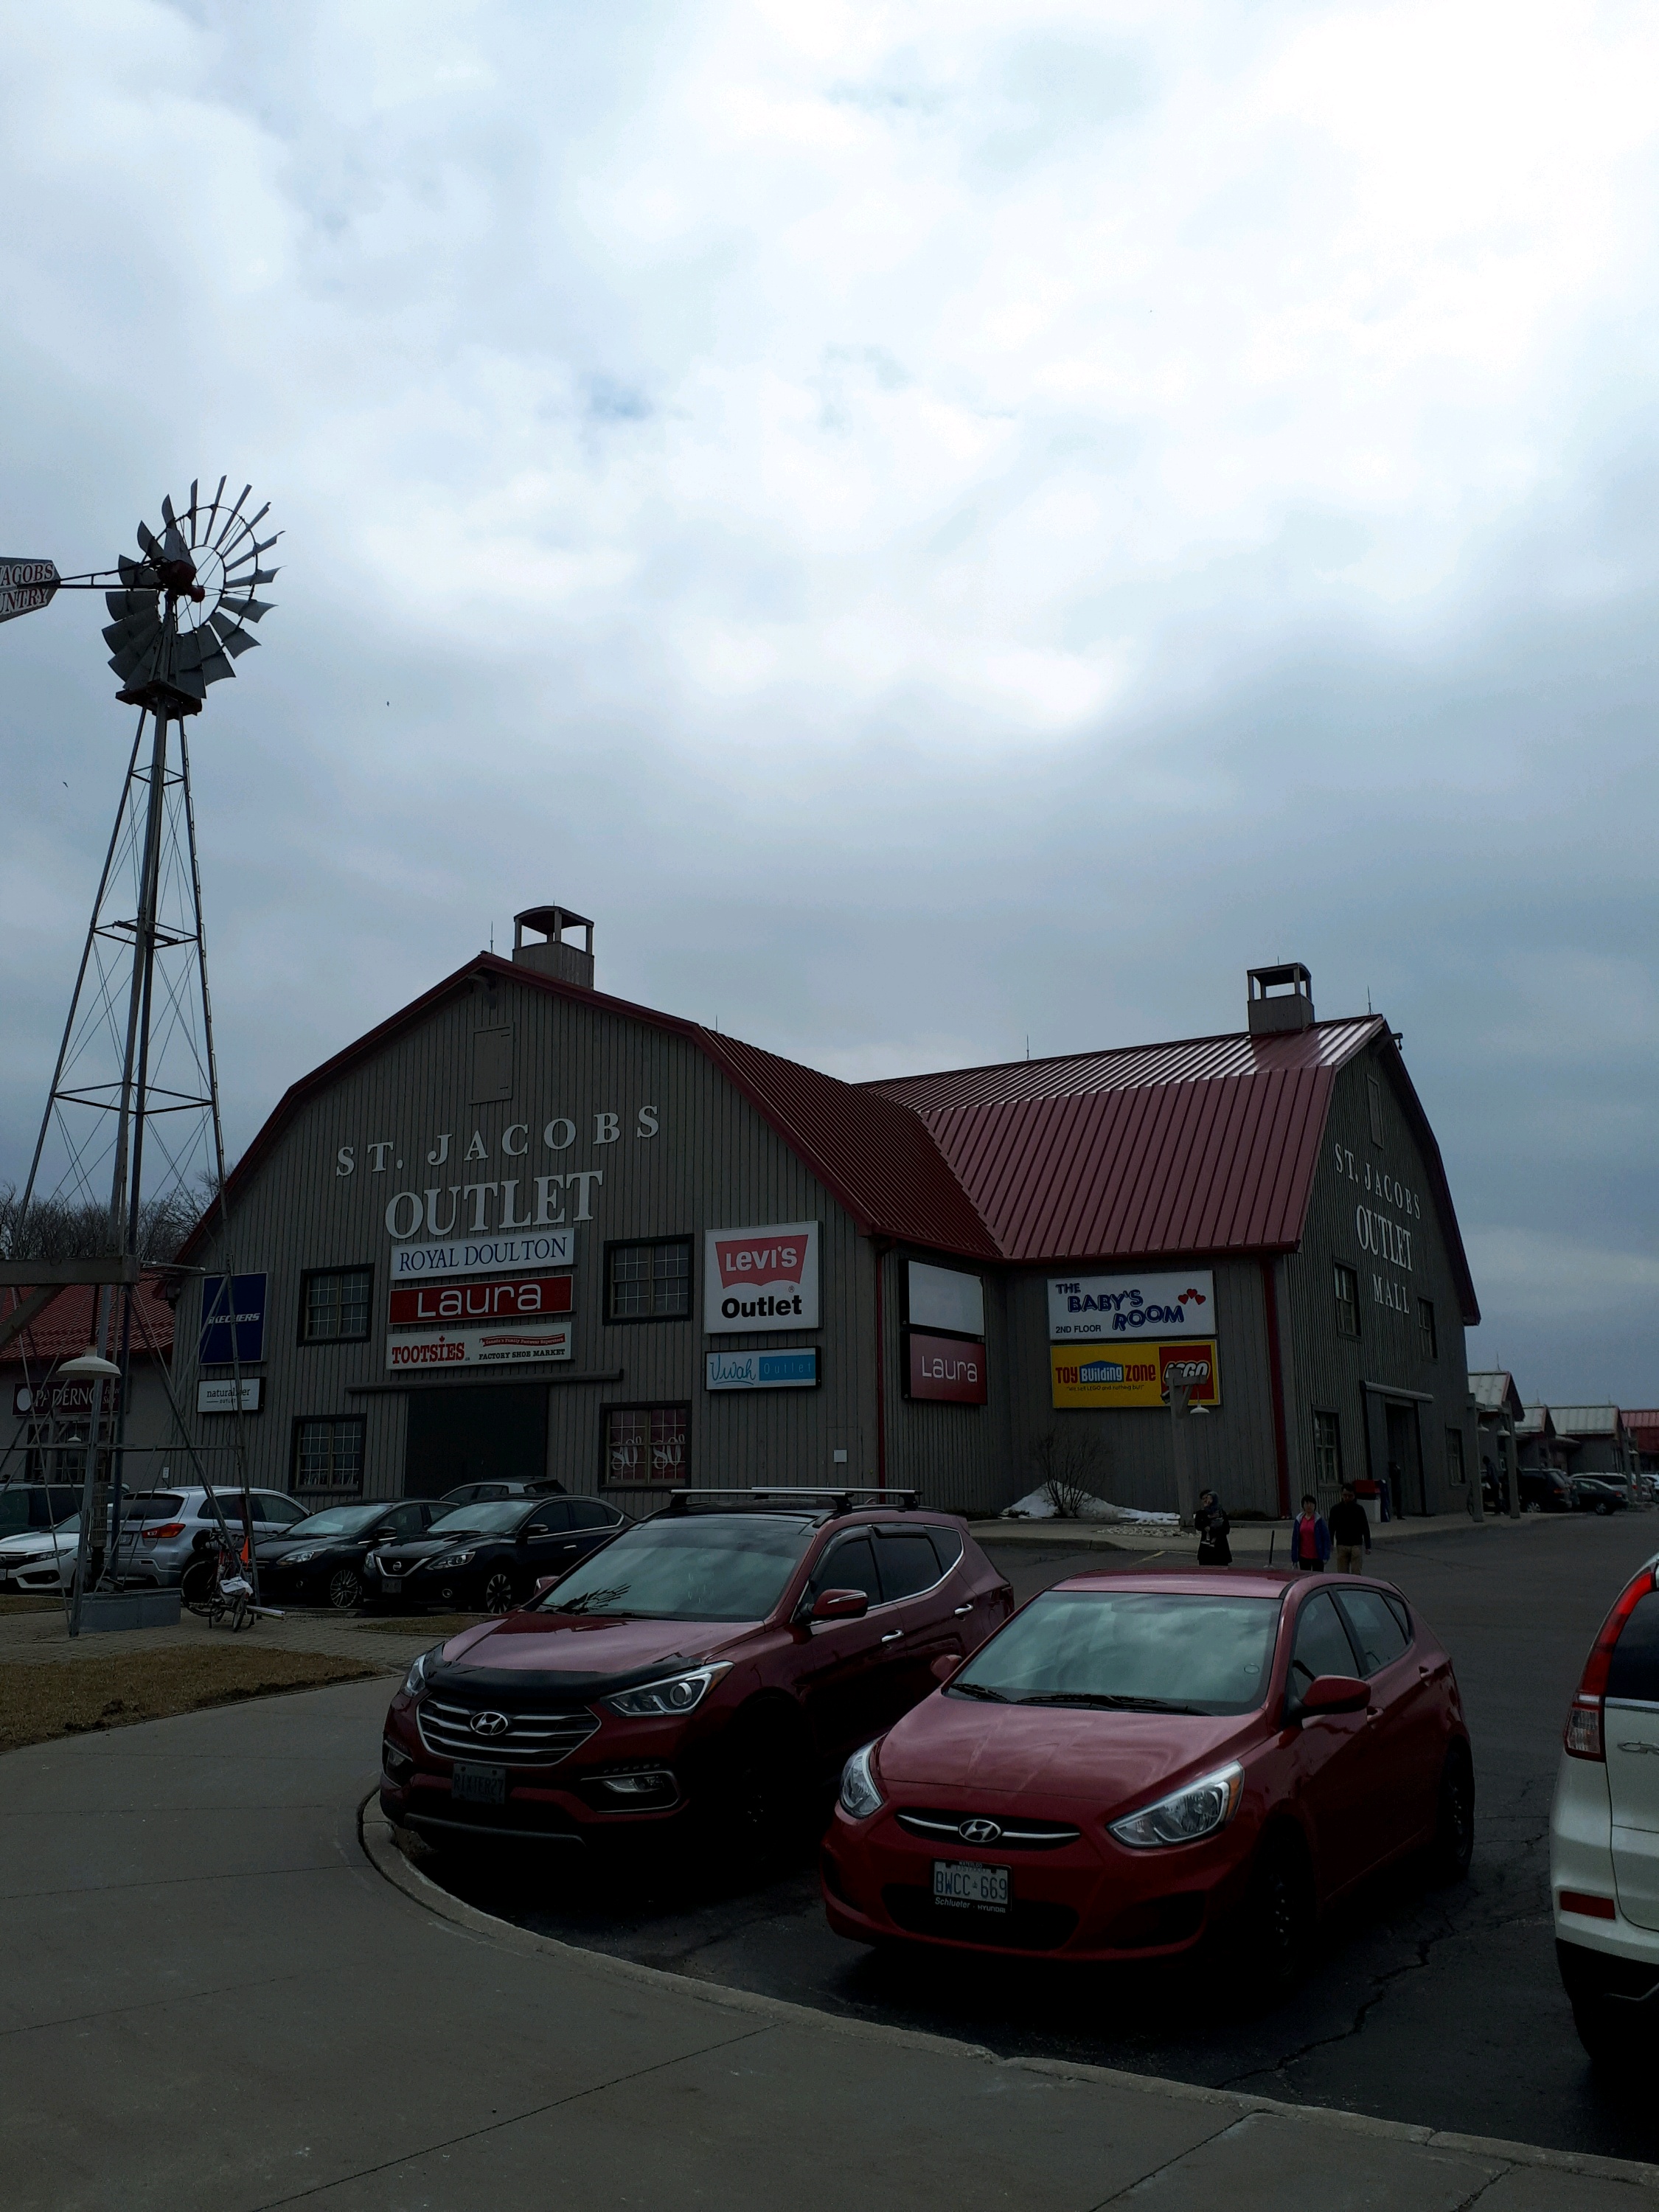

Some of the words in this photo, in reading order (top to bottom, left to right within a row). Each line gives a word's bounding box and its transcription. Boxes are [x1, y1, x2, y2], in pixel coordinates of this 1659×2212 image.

[0, 564, 53, 586] ACOBS
[336, 1141, 403, 1177] ST.
[428, 1105, 659, 1166] JACOBS
[1335, 1143, 1358, 1183] ST.
[1365, 1163, 1420, 1220] JACOBS
[386, 1170, 603, 1239] OUTLET
[1357, 1204, 1413, 1272] OUTLET
[399, 1248, 459, 1272] ROYAL
[465, 1237, 568, 1266] DOULTON
[1055, 1283, 1081, 1294] THE
[1372, 1273, 1410, 1314] MALL
[417, 1284, 542, 1318] Laura
[721, 1295, 802, 1319] Outlet
[1068, 1290, 1143, 1312] BABY'S
[1074, 1325, 1102, 1333] FLOOR
[1112, 1305, 1184, 1332] ROOM
[392, 1342, 465, 1364] TOOTSIES
[479, 1352, 510, 1360] FACTORY
[533, 1349, 566, 1357] MARKET
[764, 1362, 811, 1374] Outlet
[922, 1355, 978, 1382] Laura
[1055, 1366, 1078, 1384] TOY
[1081, 1366, 1123, 1382] Building
[206, 1388, 251, 1397] naturaler
[981, 1876, 1007, 1900] 669
